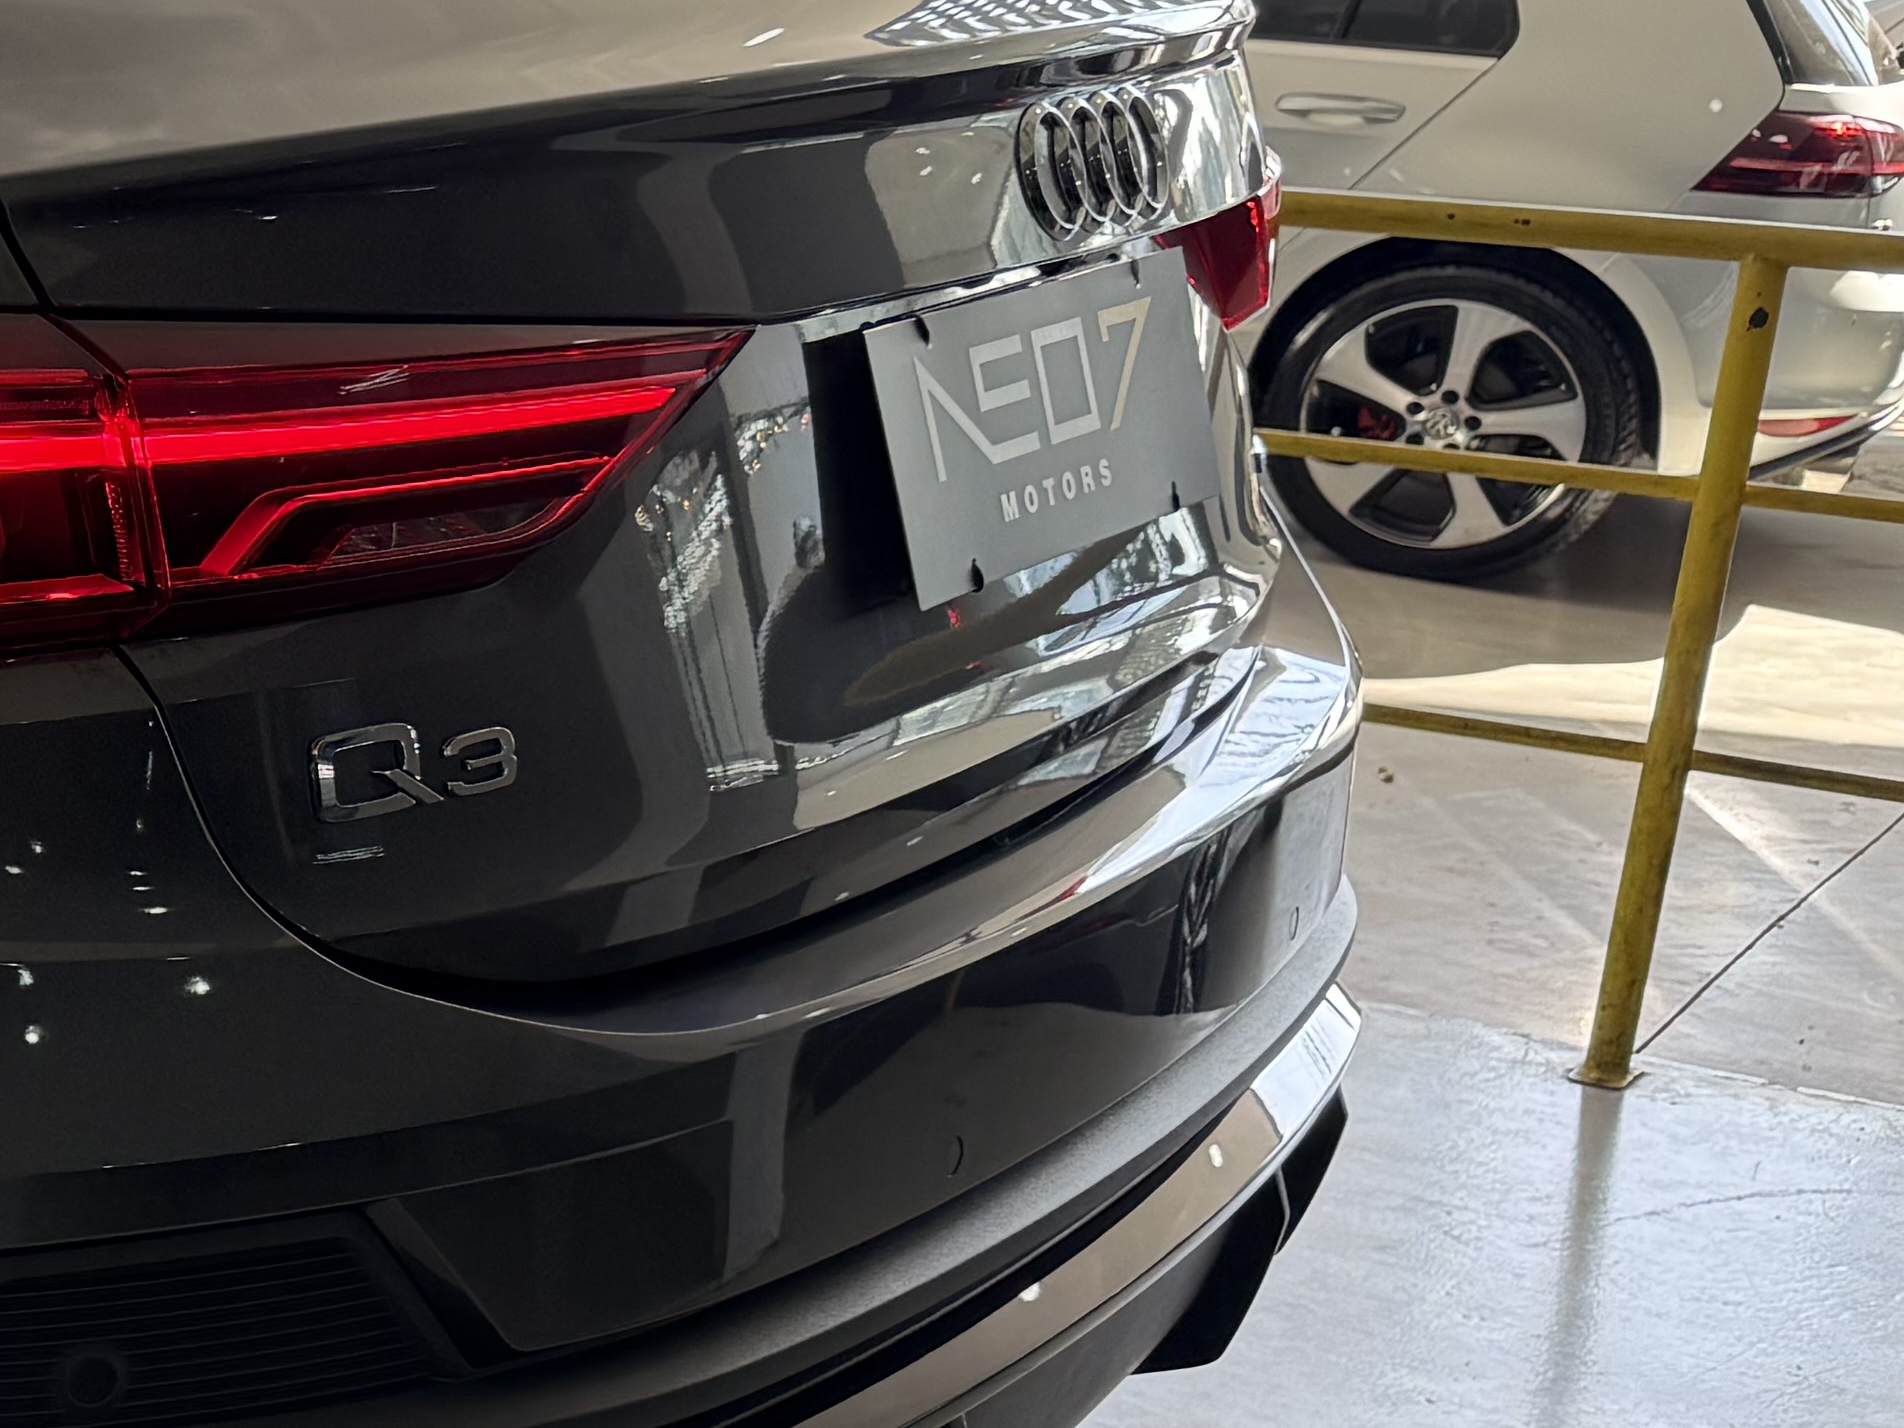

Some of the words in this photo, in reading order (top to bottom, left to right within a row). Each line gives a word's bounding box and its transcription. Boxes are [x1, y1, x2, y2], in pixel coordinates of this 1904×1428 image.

[913, 298, 1150, 482] NEO7
[1000, 459, 1113, 523] MOTORS
[312, 723, 517, 822] Q3
